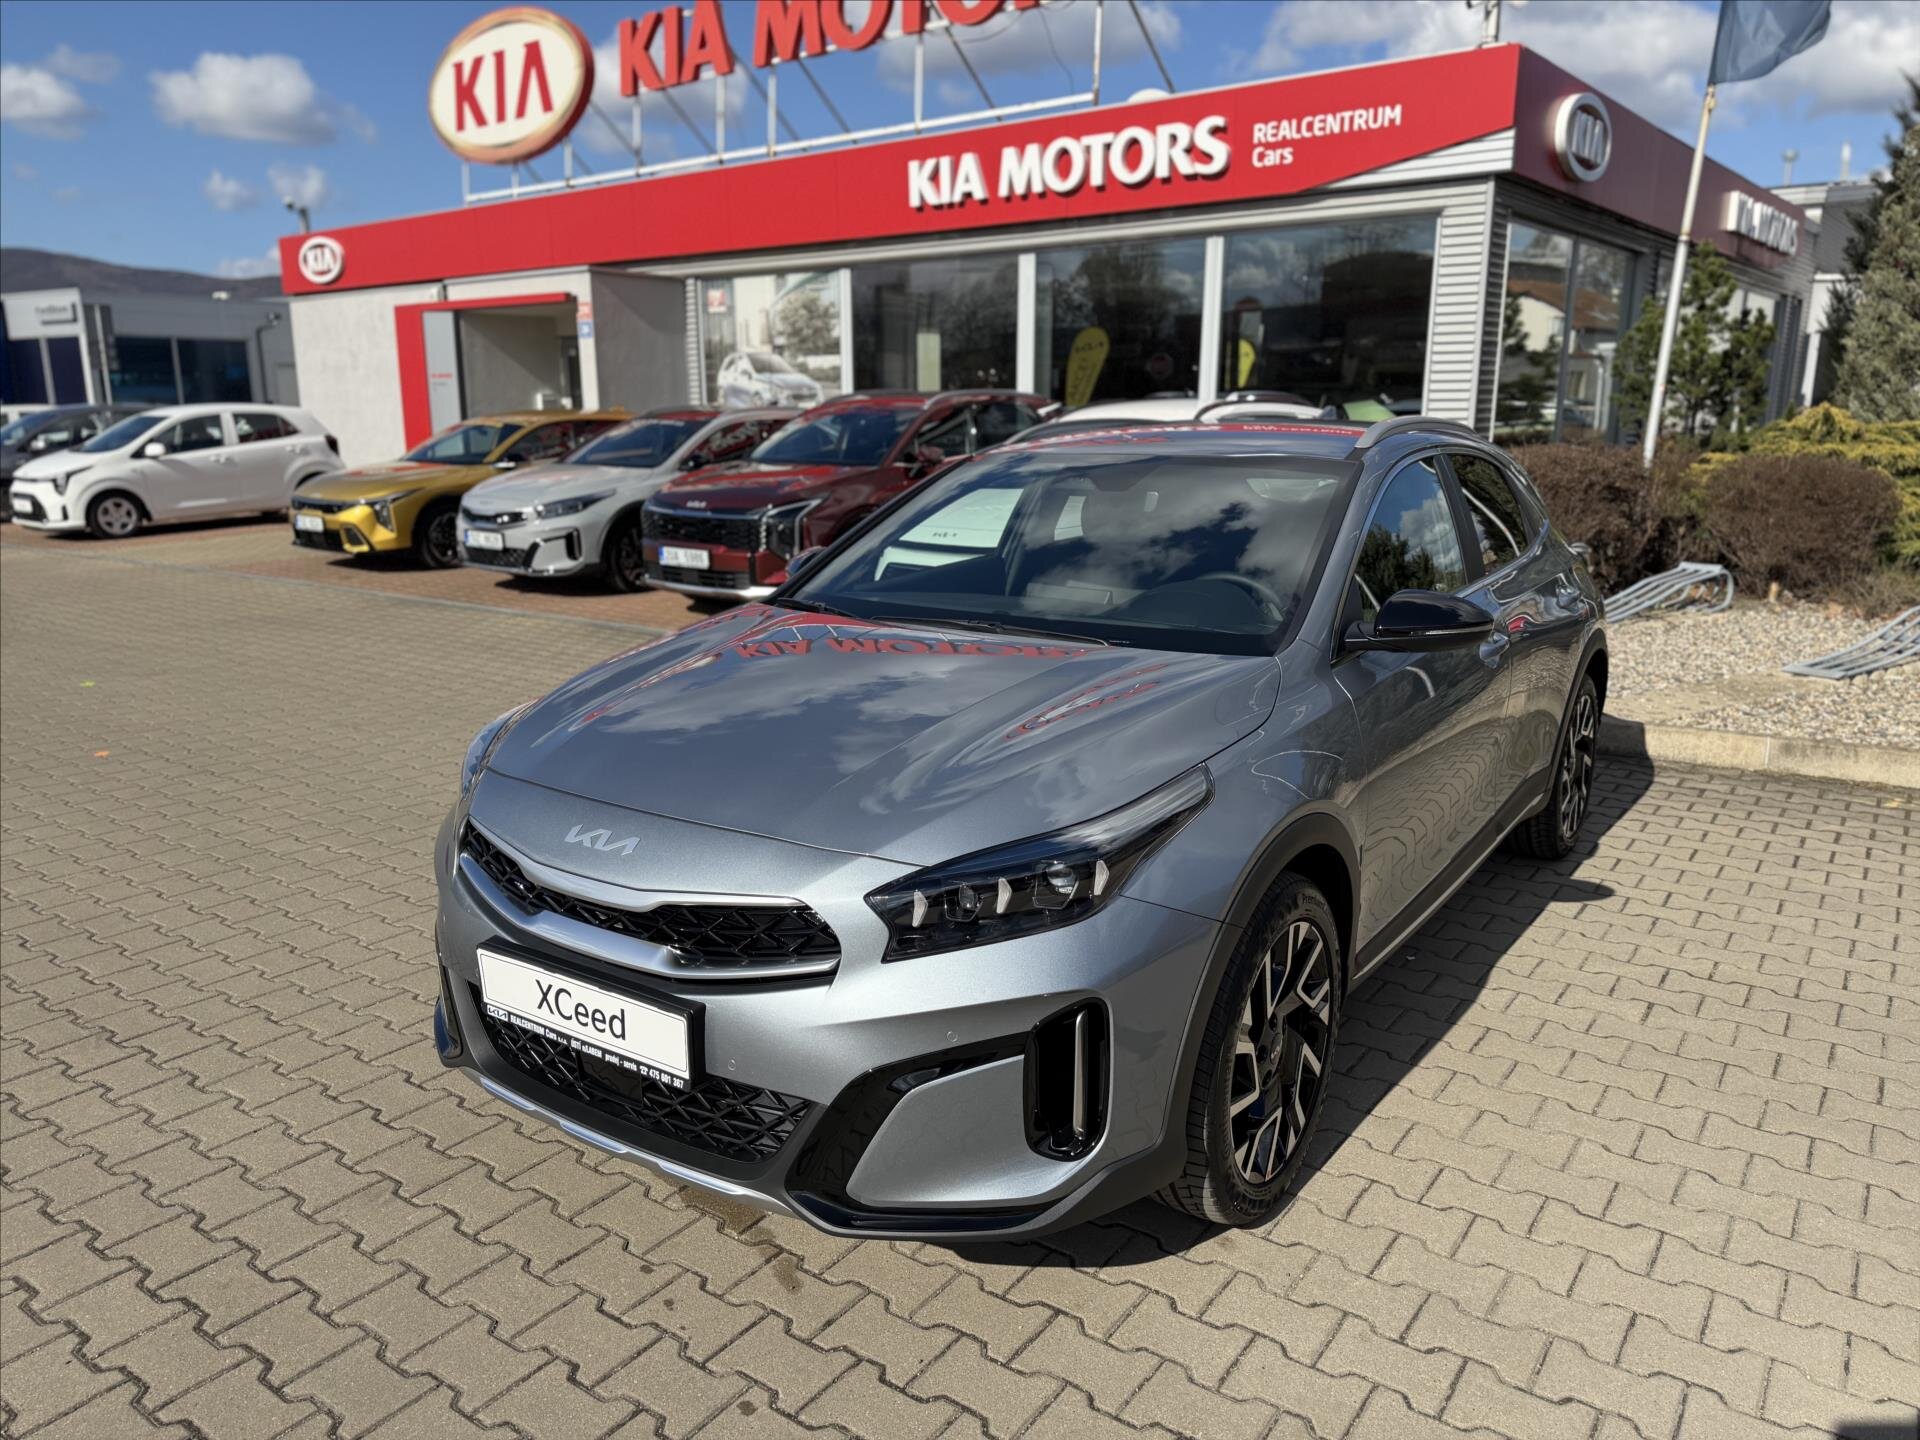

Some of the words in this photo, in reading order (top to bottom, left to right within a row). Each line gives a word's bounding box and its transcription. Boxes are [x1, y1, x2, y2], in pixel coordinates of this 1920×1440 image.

[619, 0, 733, 97] KIA
[453, 40, 553, 133] KIA
[1253, 104, 1402, 144] REALCENTRUM
[908, 153, 987, 210] KIA
[999, 115, 1230, 200] MOTORS
[1252, 146, 1294, 168] Cars
[307, 247, 336, 273] KIA
[564, 824, 641, 856] KIA
[489, 1008, 507, 1019] KIA
[535, 980, 626, 1040] XCeed
